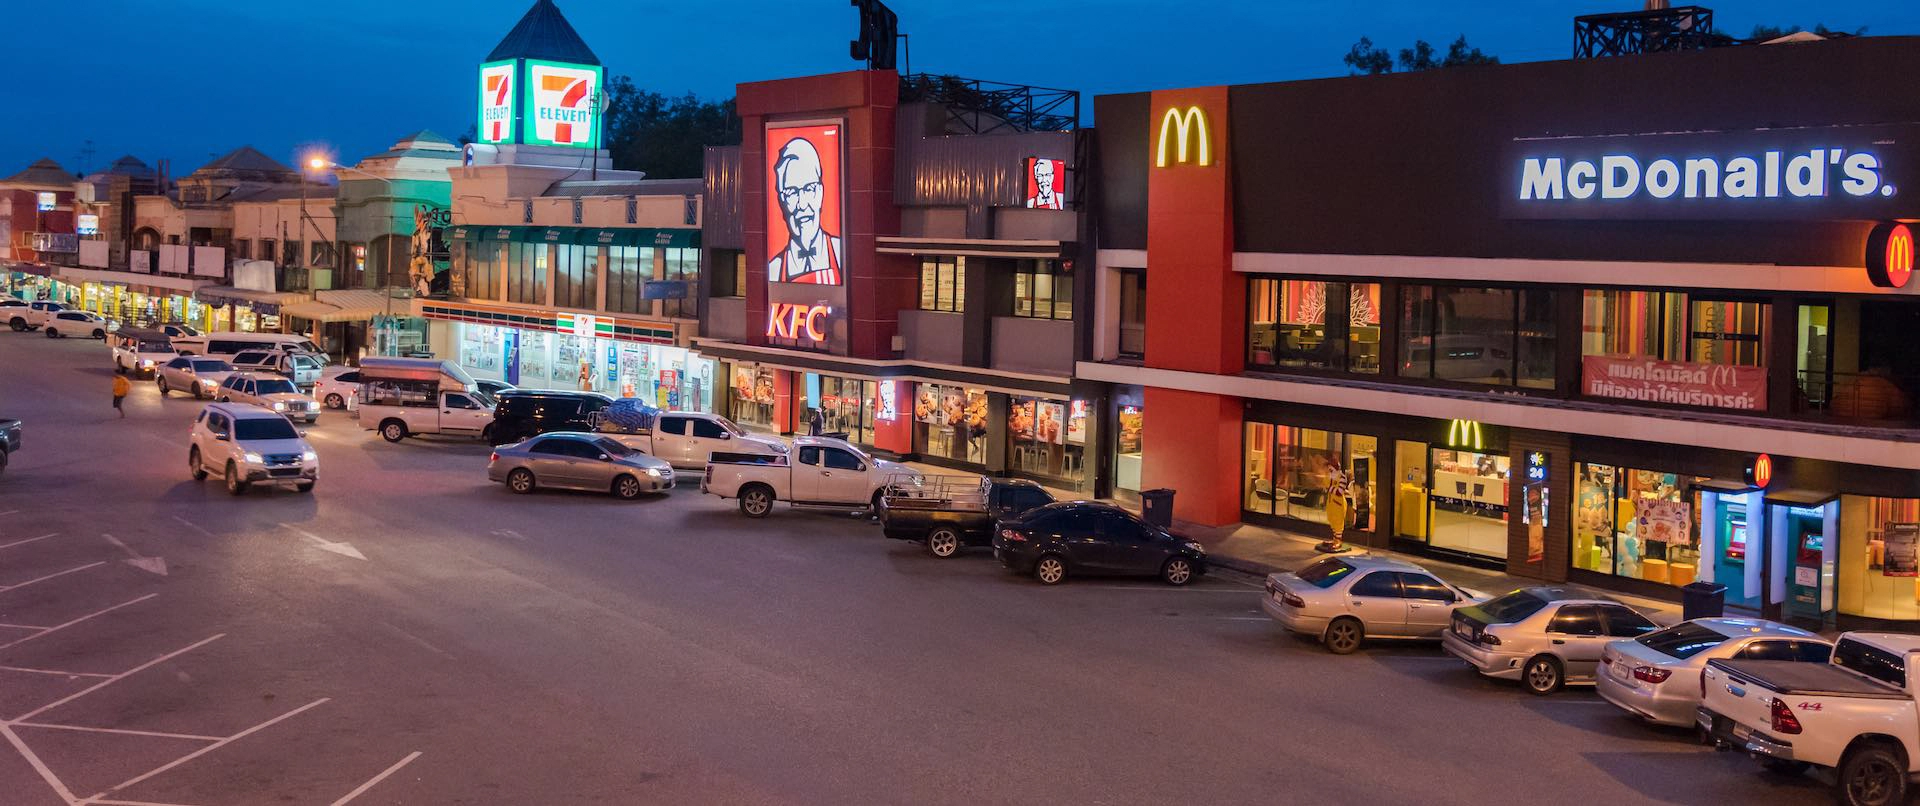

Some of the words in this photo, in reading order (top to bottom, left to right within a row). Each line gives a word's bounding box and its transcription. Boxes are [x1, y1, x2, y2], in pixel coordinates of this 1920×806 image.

[487, 75, 509, 141] 7
[542, 75, 587, 143] 7
[1519, 149, 1879, 200] McDonald's
[766, 303, 827, 341] KFC
[1529, 467, 1544, 478] 24
